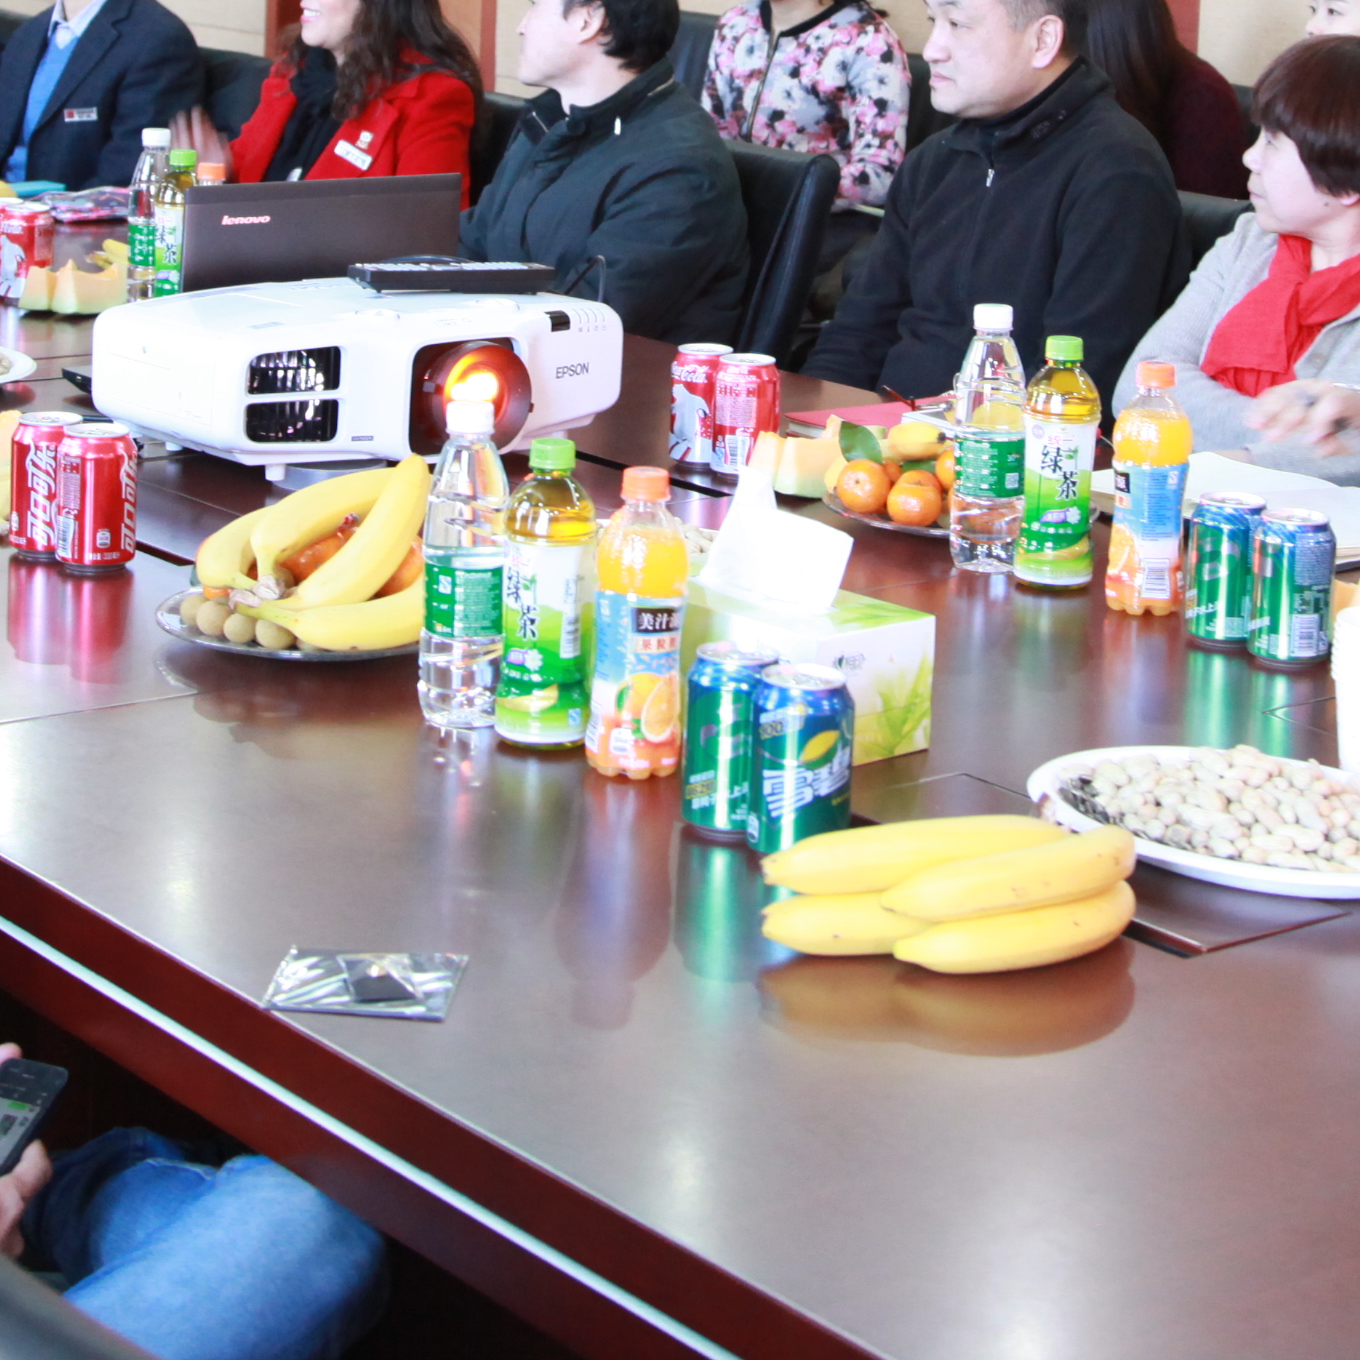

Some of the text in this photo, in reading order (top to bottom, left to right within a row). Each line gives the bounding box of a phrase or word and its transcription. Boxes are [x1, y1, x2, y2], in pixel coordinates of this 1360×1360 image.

[221, 215, 271, 226] lenovo
[555, 362, 590, 379] EPSON
[1041, 444, 1078, 501] 绿茶
